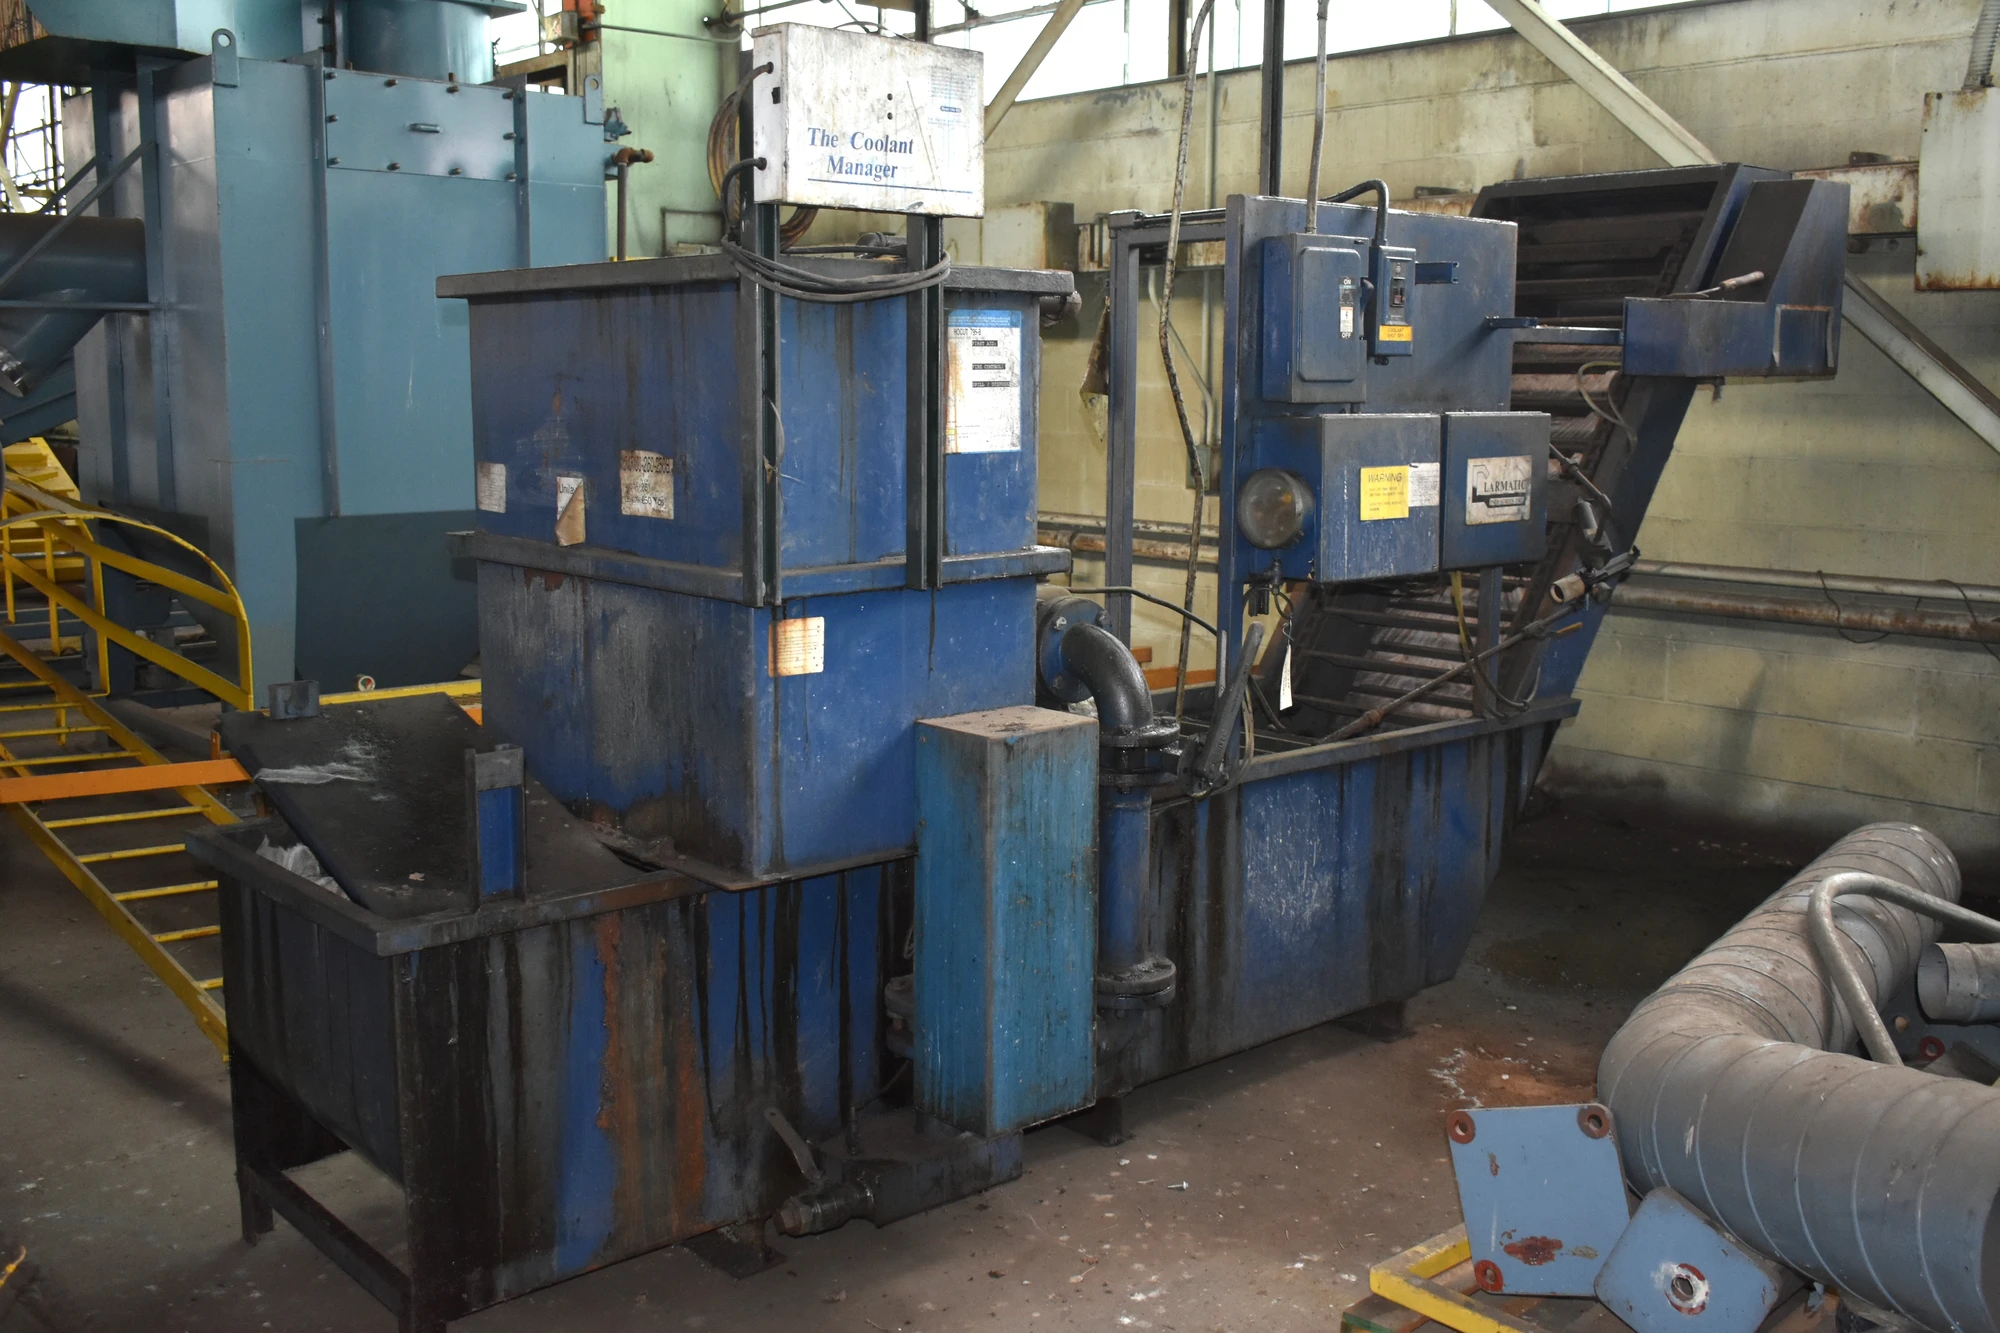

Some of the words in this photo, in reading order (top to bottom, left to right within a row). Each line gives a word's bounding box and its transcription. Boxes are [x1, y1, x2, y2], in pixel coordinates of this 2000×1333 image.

[808, 127, 839, 148] The
[850, 131, 914, 155] Coolant
[827, 155, 898, 182] Manager
[1368, 473, 1403, 483] WARNING
[559, 484, 576, 495] Unila
